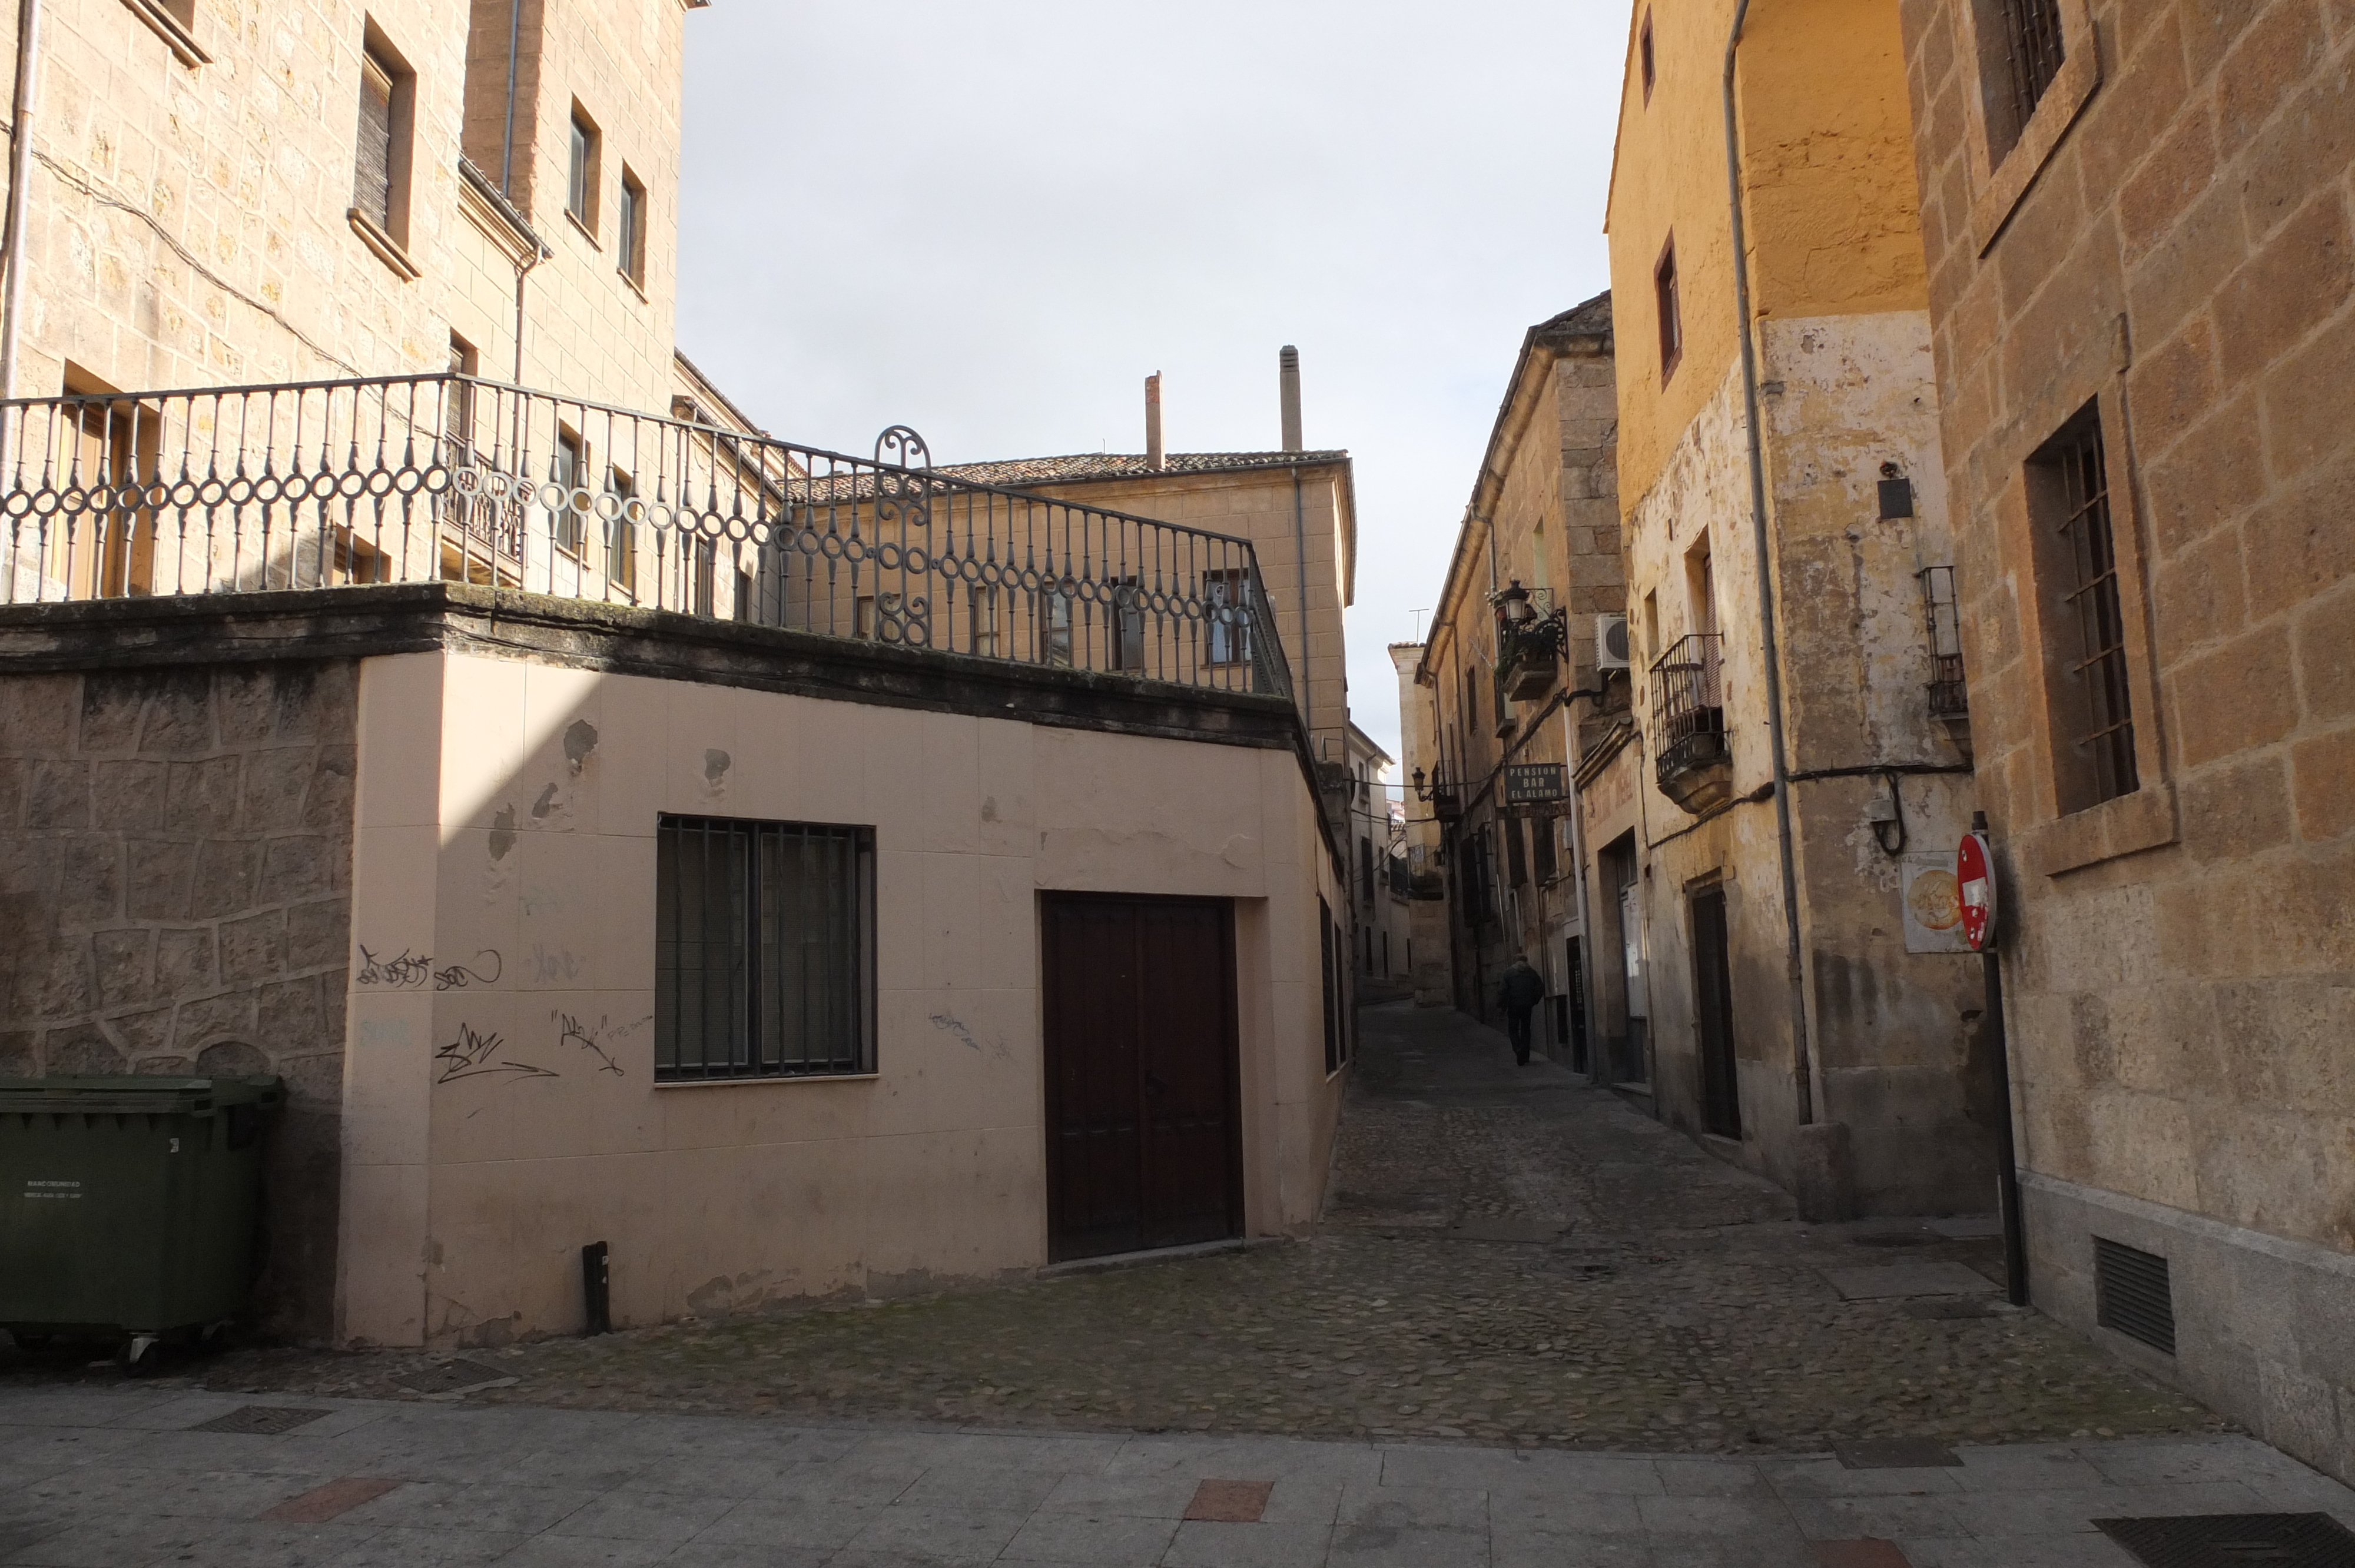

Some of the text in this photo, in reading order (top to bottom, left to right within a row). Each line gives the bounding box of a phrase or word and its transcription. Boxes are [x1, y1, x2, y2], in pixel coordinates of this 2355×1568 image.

[1510, 766, 1556, 776] PENSION
[1523, 778, 1544, 788] BAR
[1511, 789, 1558, 799] EL ALAMO
